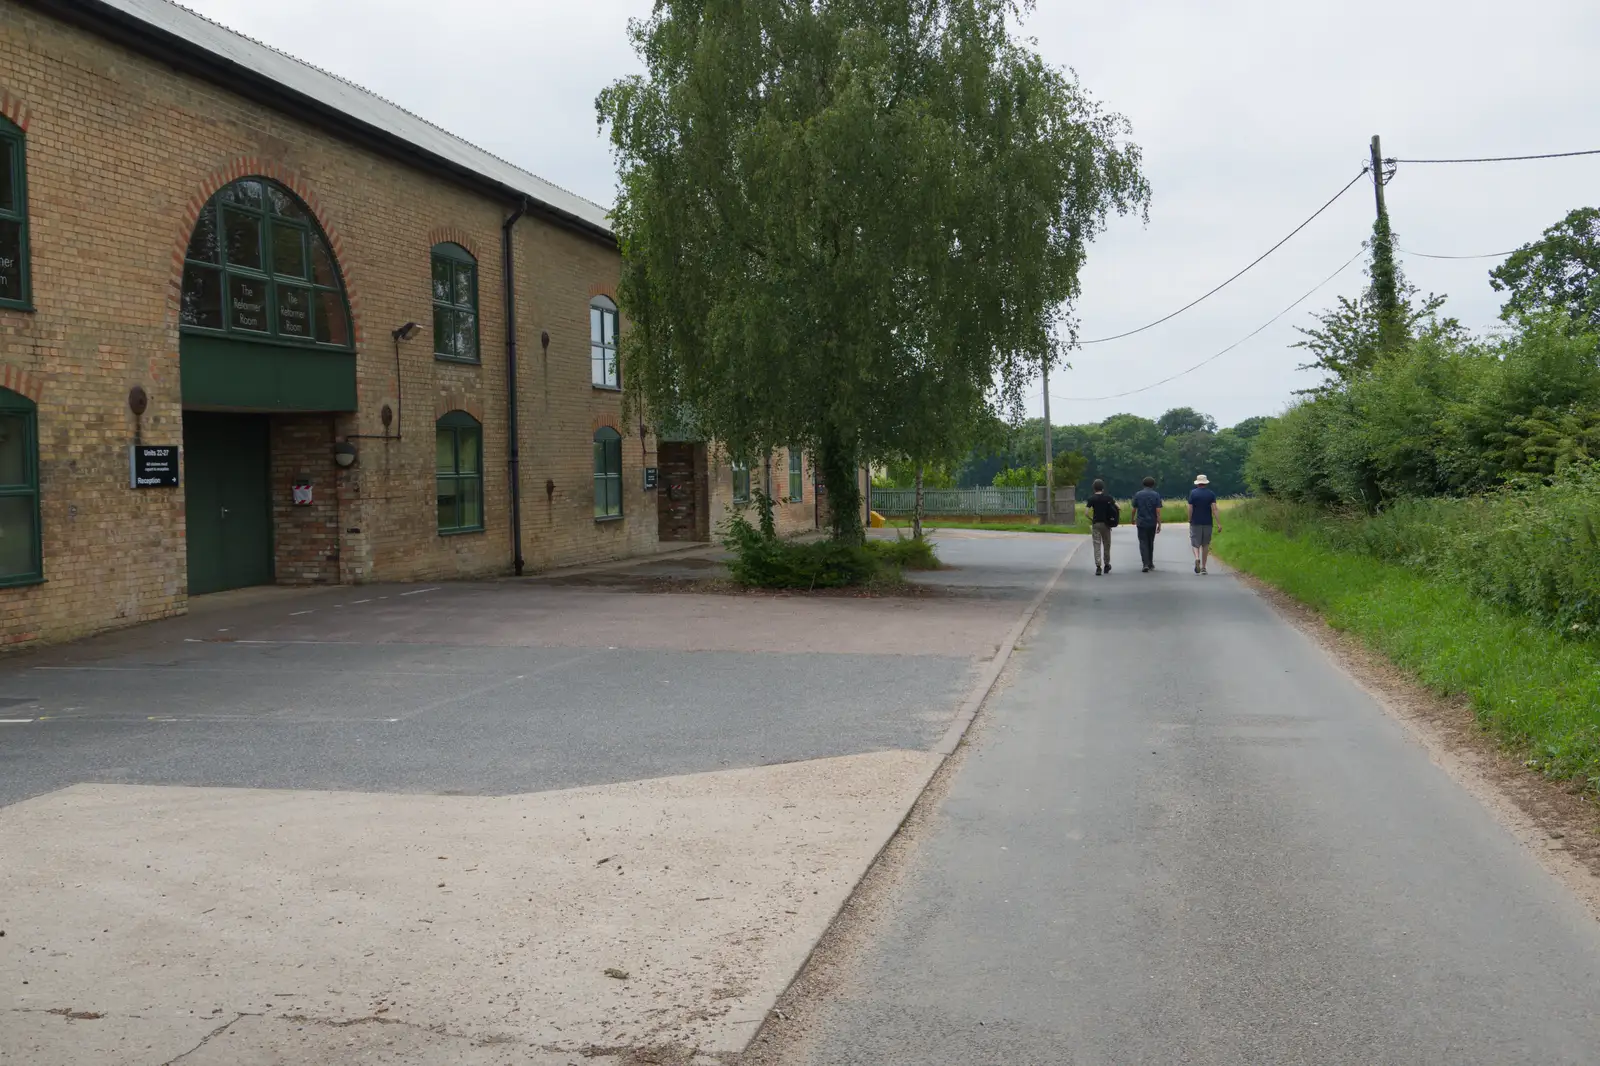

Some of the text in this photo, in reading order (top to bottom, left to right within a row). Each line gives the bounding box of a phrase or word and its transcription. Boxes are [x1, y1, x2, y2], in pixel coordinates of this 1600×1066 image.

[241, 284, 253, 297] The
[233, 297, 261, 312] Reformer
[287, 292, 298, 305] The
[280, 305, 305, 319] Reformer
[239, 312, 258, 326] Room
[285, 320, 303, 333] Room
[143, 449, 169, 457] Units 22-27
[137, 477, 161, 485] Reception
